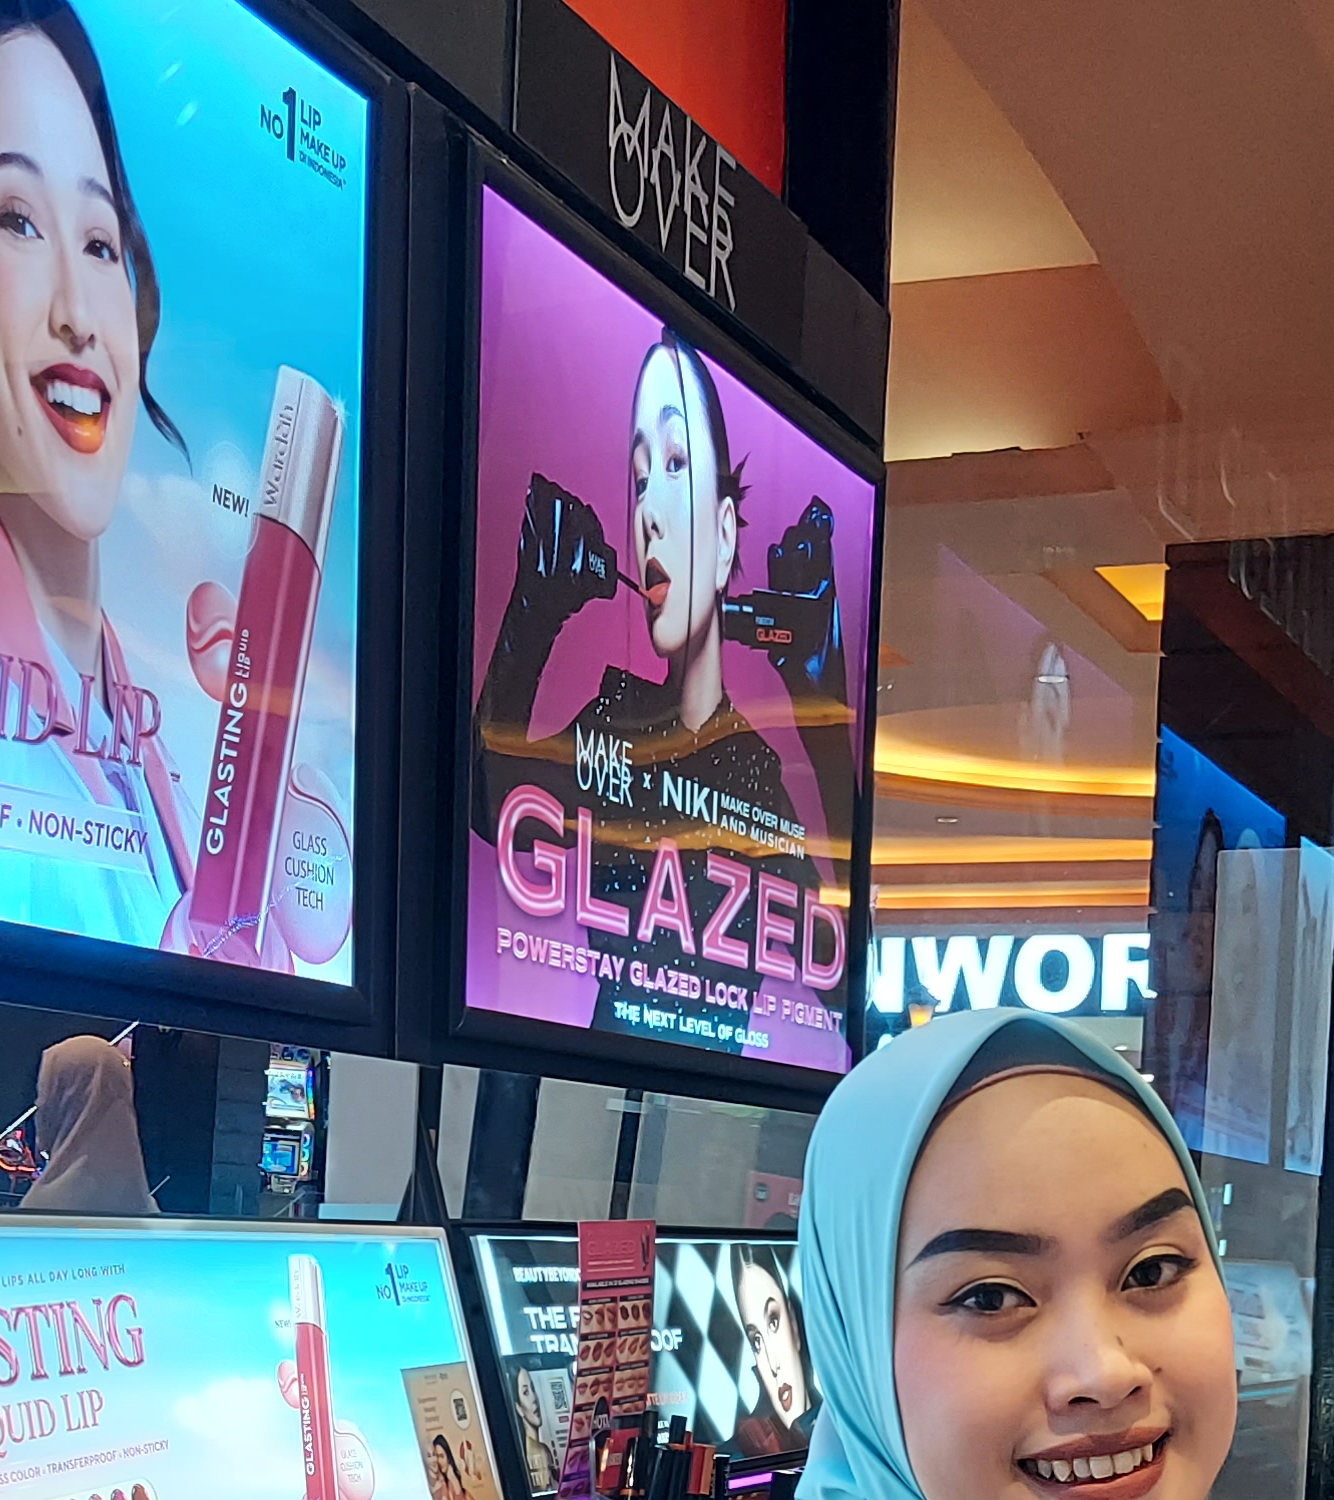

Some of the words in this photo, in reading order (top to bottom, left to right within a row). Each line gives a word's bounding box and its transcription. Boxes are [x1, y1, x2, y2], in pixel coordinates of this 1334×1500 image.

[260, 104, 284, 139] NO
[283, 87, 296, 162] 1
[301, 99, 322, 131] LIP
[301, 127, 330, 163] MAKE
[332, 150, 346, 172] UP
[212, 483, 250, 517] NEW!
[235, 629, 249, 676] LIQUID
[241, 656, 250, 678] LIP
[73, 675, 163, 768] LIP
[204, 682, 248, 855] GLASTING
[662, 771, 719, 825] NIKI
[721, 794, 750, 819] MAKE
[752, 807, 778, 829] OVER
[780, 818, 805, 841] MUSE
[28, 814, 148, 856] NON-STICKY
[292, 830, 328, 857] GLASS
[720, 814, 747, 839] AND
[750, 825, 805, 860] MUSICIAN
[284, 857, 335, 888] CUSHION
[498, 784, 846, 991] GLAZED
[296, 887, 325, 912] TECH
[496, 927, 625, 983] POWERSTAY
[630, 960, 701, 999] GLAZED
[705, 979, 748, 1012] LOCK
[753, 991, 776, 1014] LIP
[781, 1000, 843, 1033] PIGMENT
[614, 1003, 640, 1025] THE
[643, 1009, 676, 1031] NEXT
[679, 1015, 715, 1039] LEVEL
[718, 1022, 733, 1041] OF
[734, 1026, 769, 1049] GLOSS
[2, 1274, 24, 1288] LIPS
[27, 1272, 46, 1285] ALL
[49, 1269, 69, 1283] DAY
[72, 1266, 98, 1280] LONG
[100, 1264, 125, 1276] WITH
[376, 1285, 392, 1300] NO
[385, 1263, 400, 1306] 1
[395, 1264, 409, 1279] LIP
[400, 1281, 419, 1292] MAKE
[523, 1307, 566, 1329] THE
[60, 1389, 103, 1432] LIP
[301, 1397, 315, 1476] GLASTING
[10, 1467, 41, 1483] COLOR
[46, 1450, 116, 1474] TRANSFERPROOF
[122, 1439, 169, 1459] NON-STICKY
